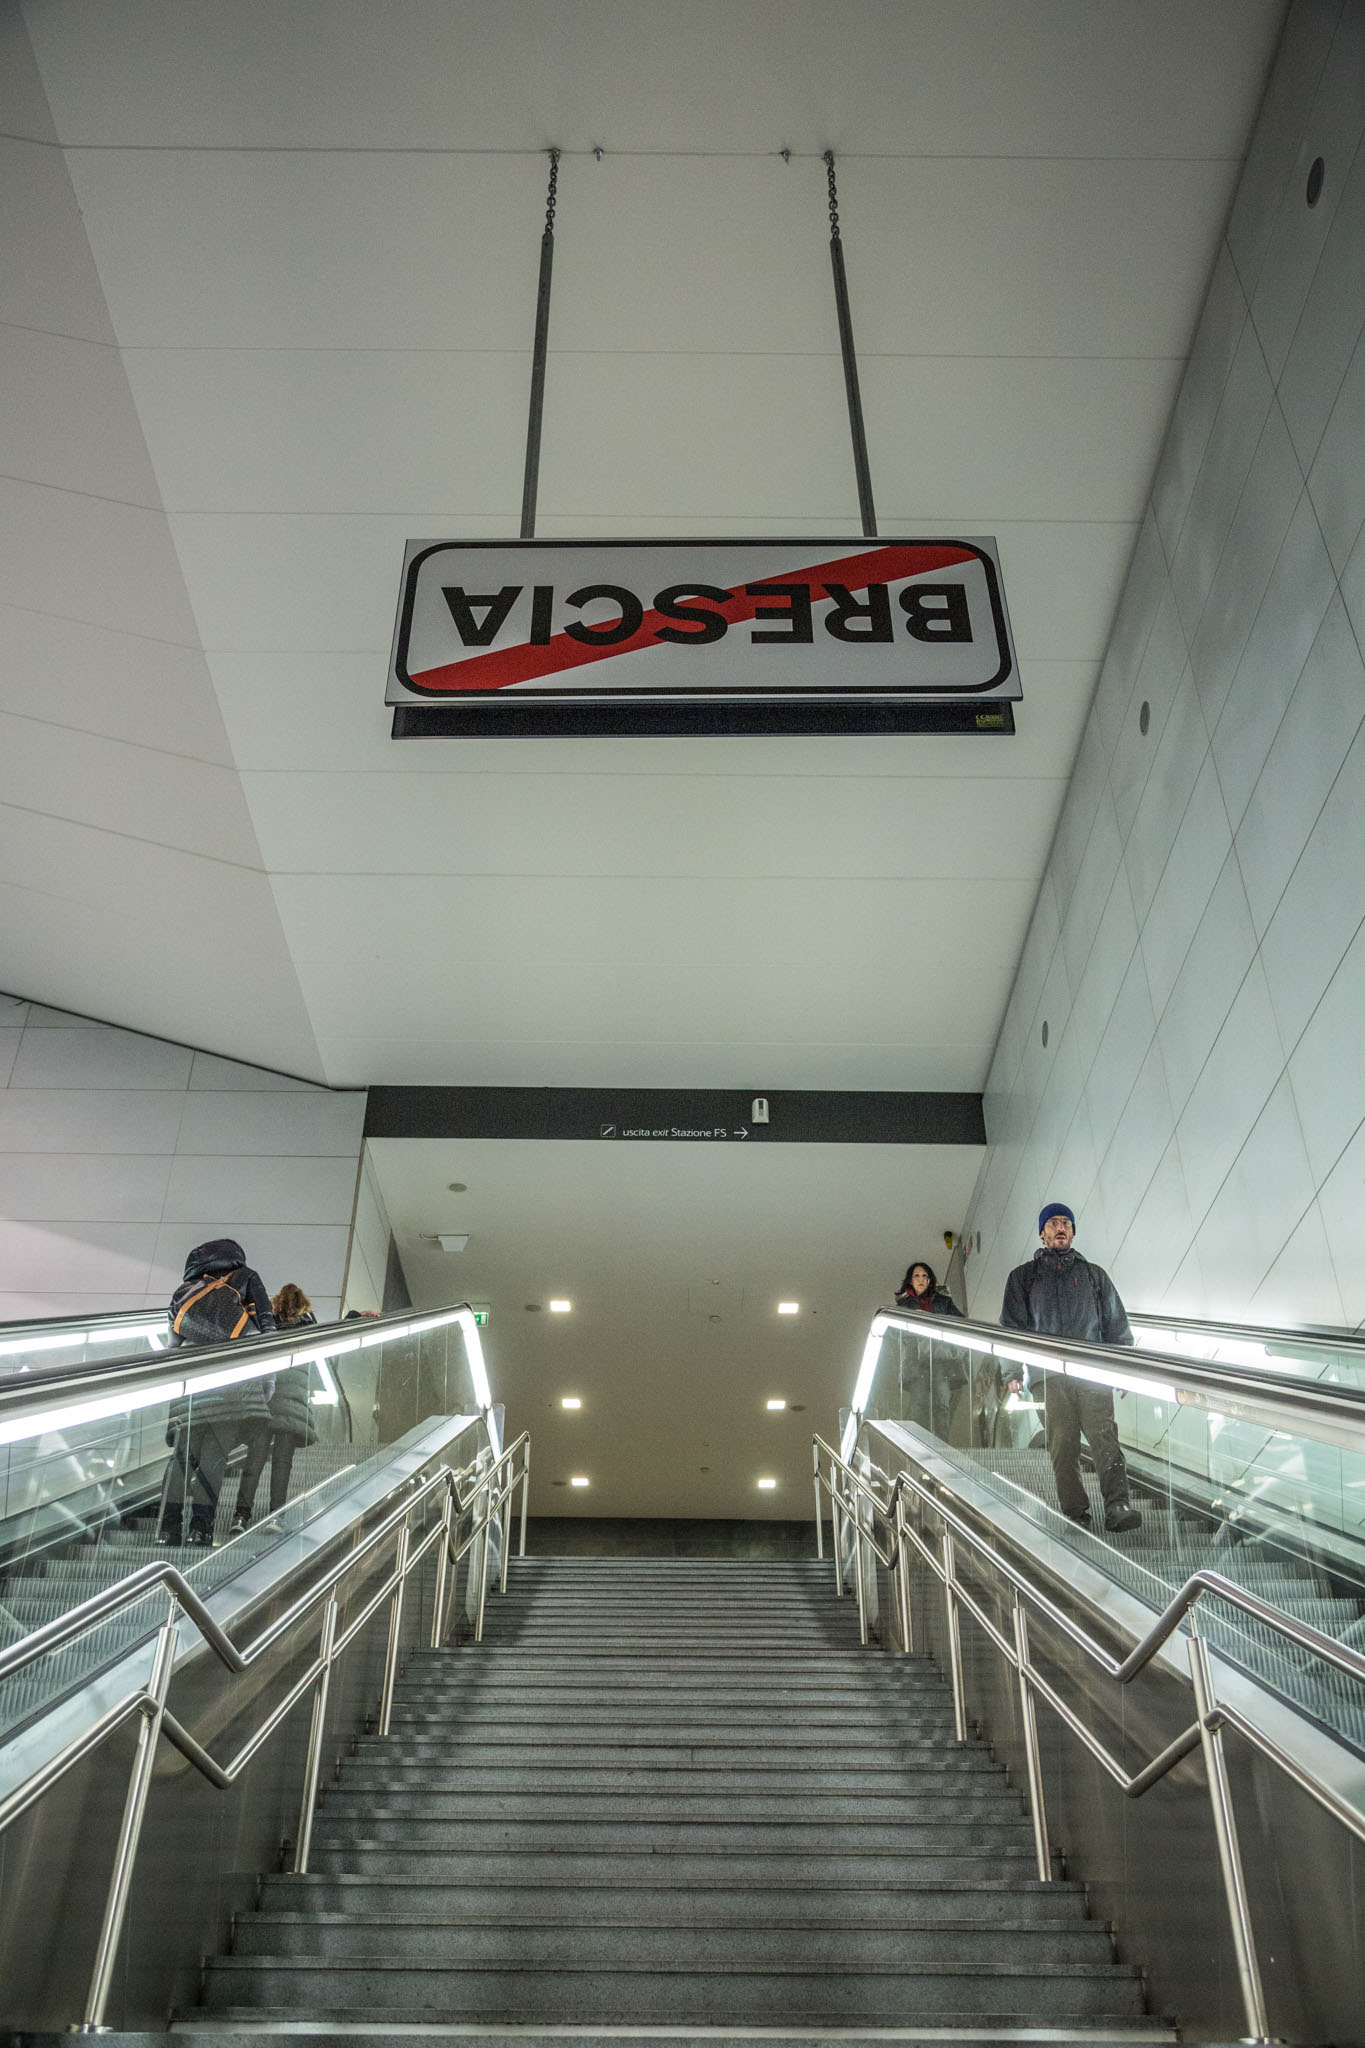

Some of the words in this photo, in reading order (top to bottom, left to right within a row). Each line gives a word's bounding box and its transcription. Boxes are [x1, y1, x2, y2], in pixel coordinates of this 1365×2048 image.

[441, 583, 974, 647] BRESCIA
[622, 1128, 650, 1137] uscita
[652, 1128, 669, 1137] exit
[671, 1127, 712, 1137] Stazione
[714, 1128, 727, 1138] FS
